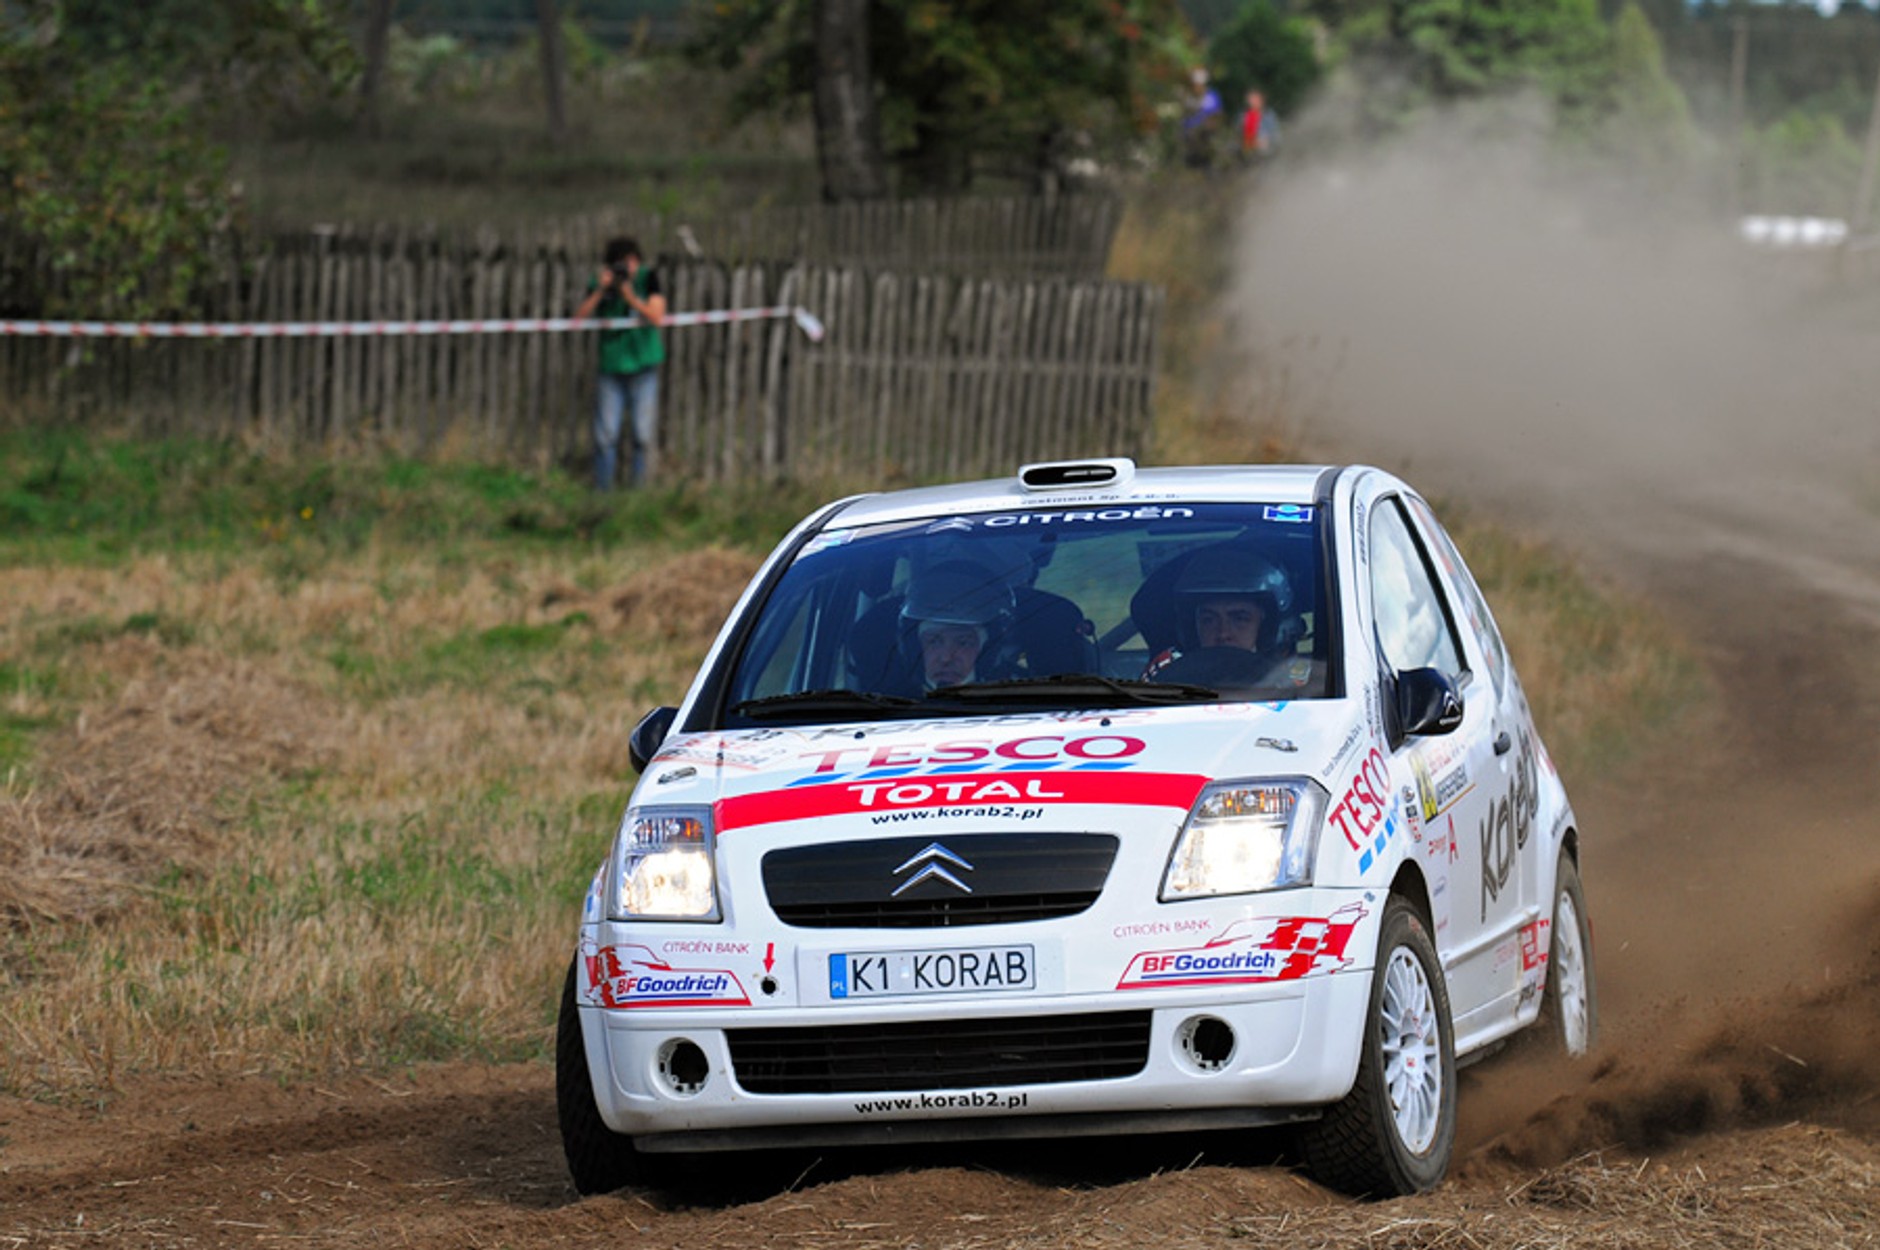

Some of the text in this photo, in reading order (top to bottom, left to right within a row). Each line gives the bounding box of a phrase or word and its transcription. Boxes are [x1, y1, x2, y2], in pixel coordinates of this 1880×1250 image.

[798, 735, 1147, 773] TESCO
[847, 779, 1065, 807] TOTAL
[1328, 747, 1391, 851] TESCO
[871, 806, 1044, 825] www.korab2.pl
[1174, 919, 1213, 932] BANK
[715, 943, 750, 954] BANK
[852, 951, 1027, 991] K1 KORAB
[1142, 951, 1276, 973] BFGoodrich
[617, 975, 728, 994] BFGoodrich
[832, 981, 846, 991] PL
[854, 1091, 1028, 1114] www.korab2.pl
